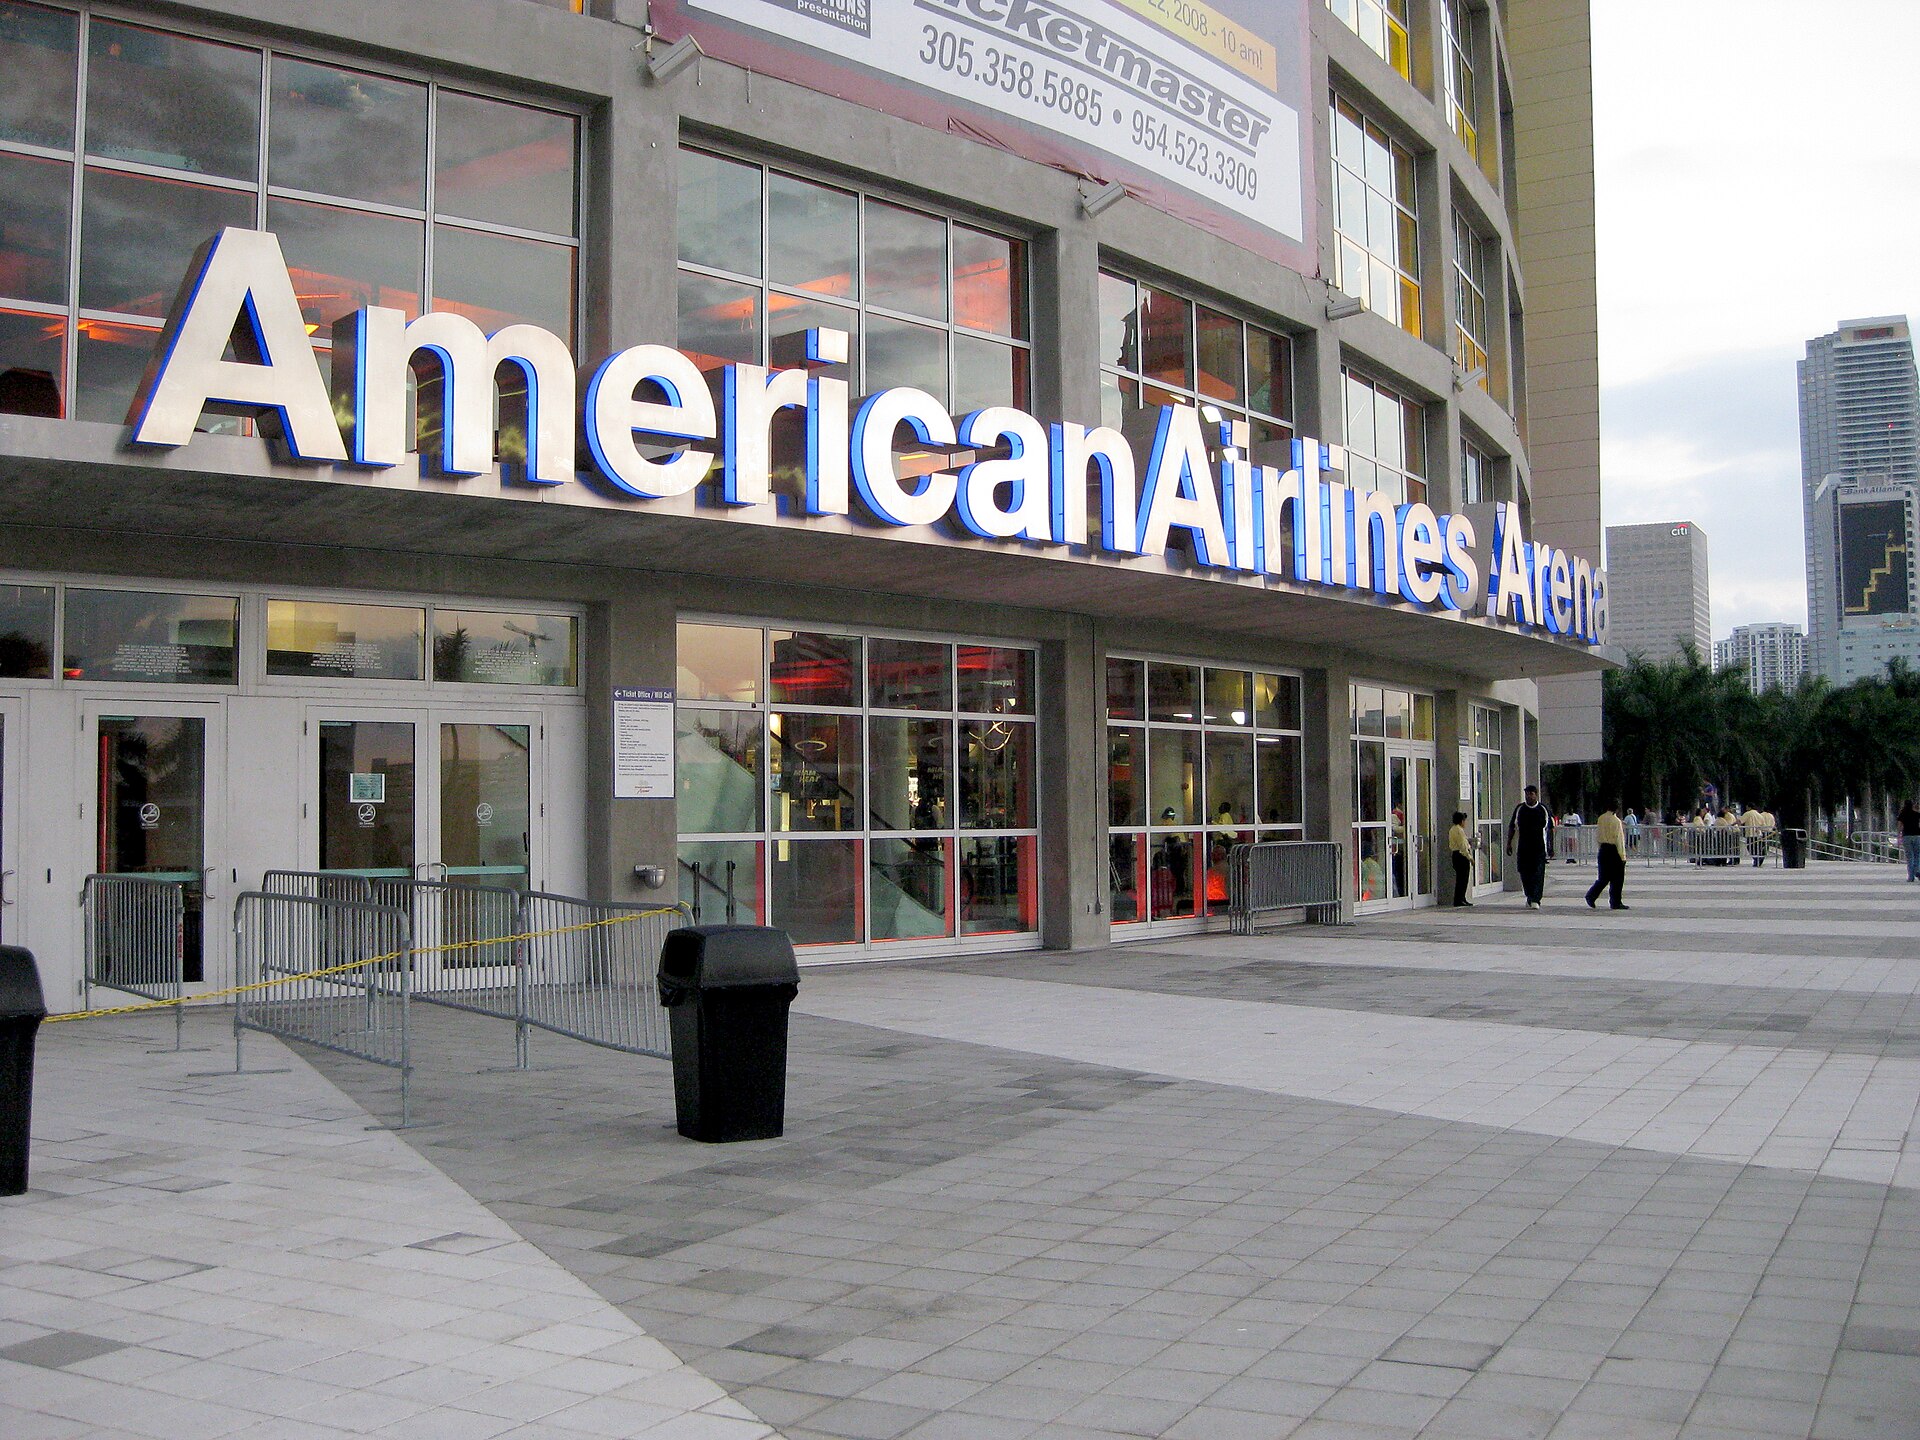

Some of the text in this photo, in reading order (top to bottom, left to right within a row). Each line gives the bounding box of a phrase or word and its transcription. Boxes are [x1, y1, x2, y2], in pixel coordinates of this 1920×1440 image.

[797, 0, 868, 31] presentation
[1173, 0, 1208, 37] 2008
[1220, 27, 1237, 53] 10
[1239, 42, 1264, 70] am!
[936, 0, 1270, 148] cketmaster
[919, 24, 1258, 201] 305.358.5885 954.523.3309
[1670, 526, 1688, 536] citi
[1494, 499, 1610, 646] Arena
[622, 689, 637, 698] Ticket
[637, 690, 651, 698] Office
